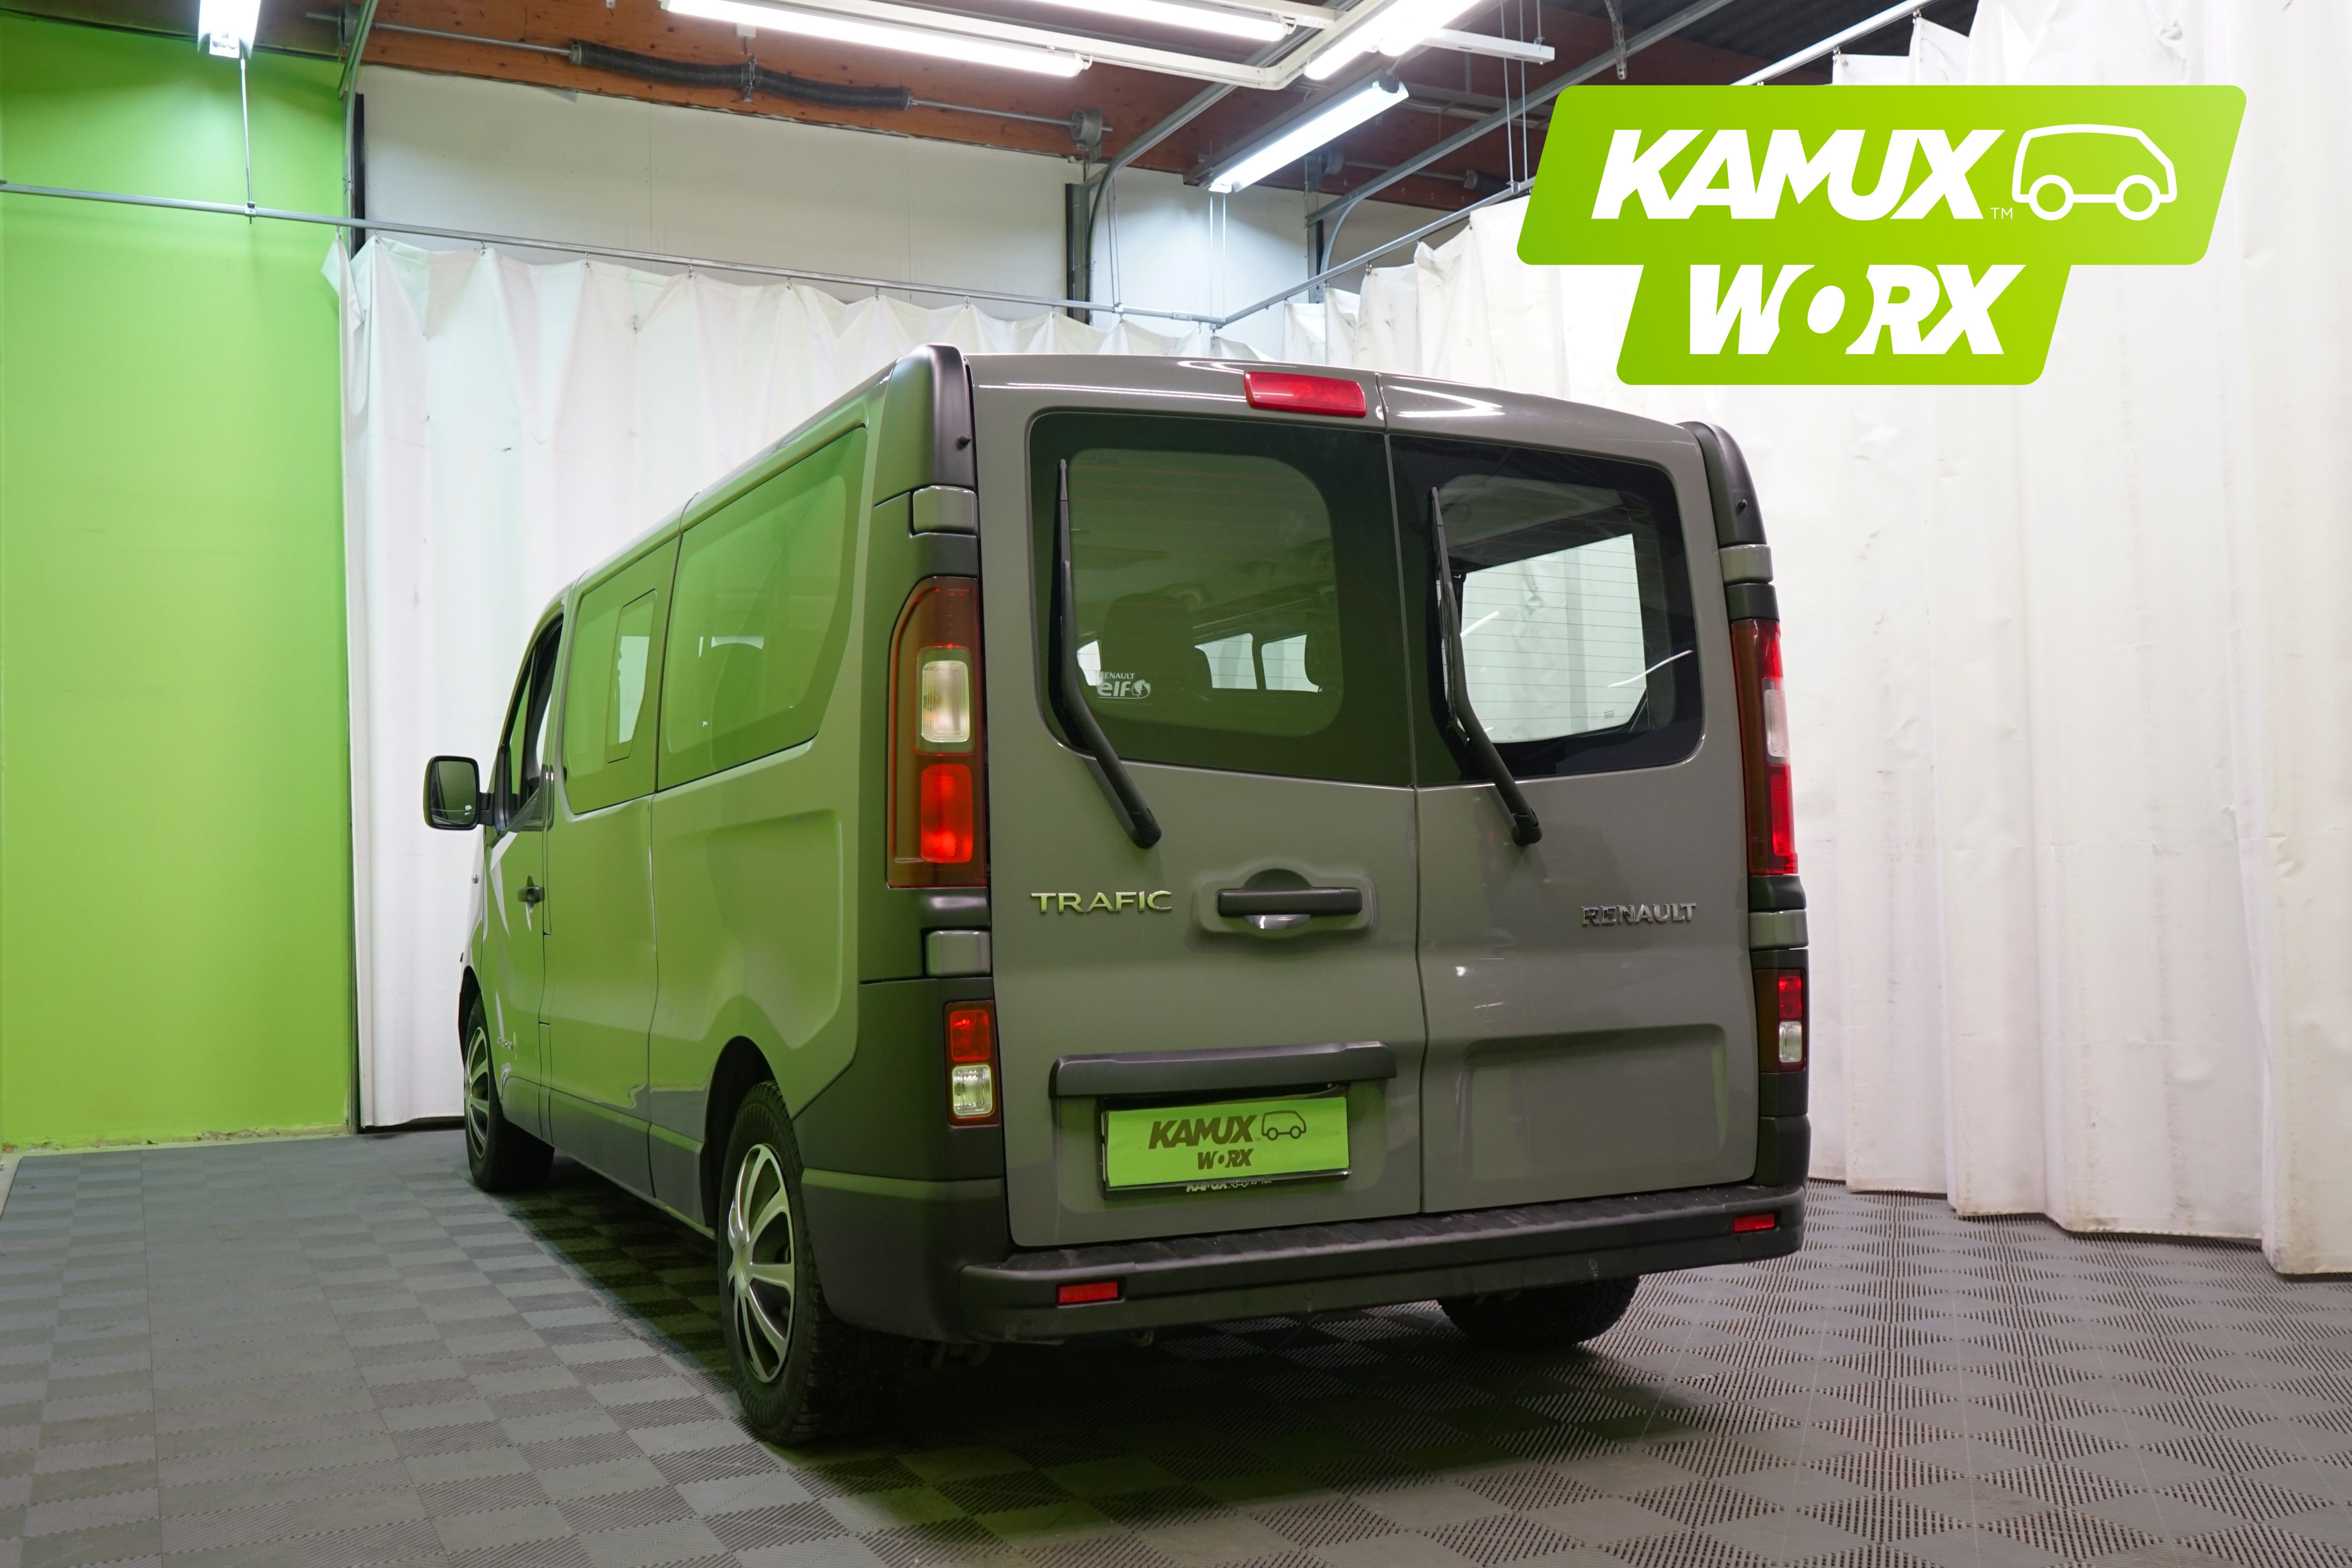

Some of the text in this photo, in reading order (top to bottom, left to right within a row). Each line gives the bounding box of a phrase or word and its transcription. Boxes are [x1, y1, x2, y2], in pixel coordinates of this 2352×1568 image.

[1097, 681, 1131, 696] elf
[1031, 890, 1172, 913] TRAFIC
[1581, 902, 1696, 924] RENAULT
[1148, 1115, 1258, 1149] KAMUX
[1198, 1148, 1254, 1170] WORX
